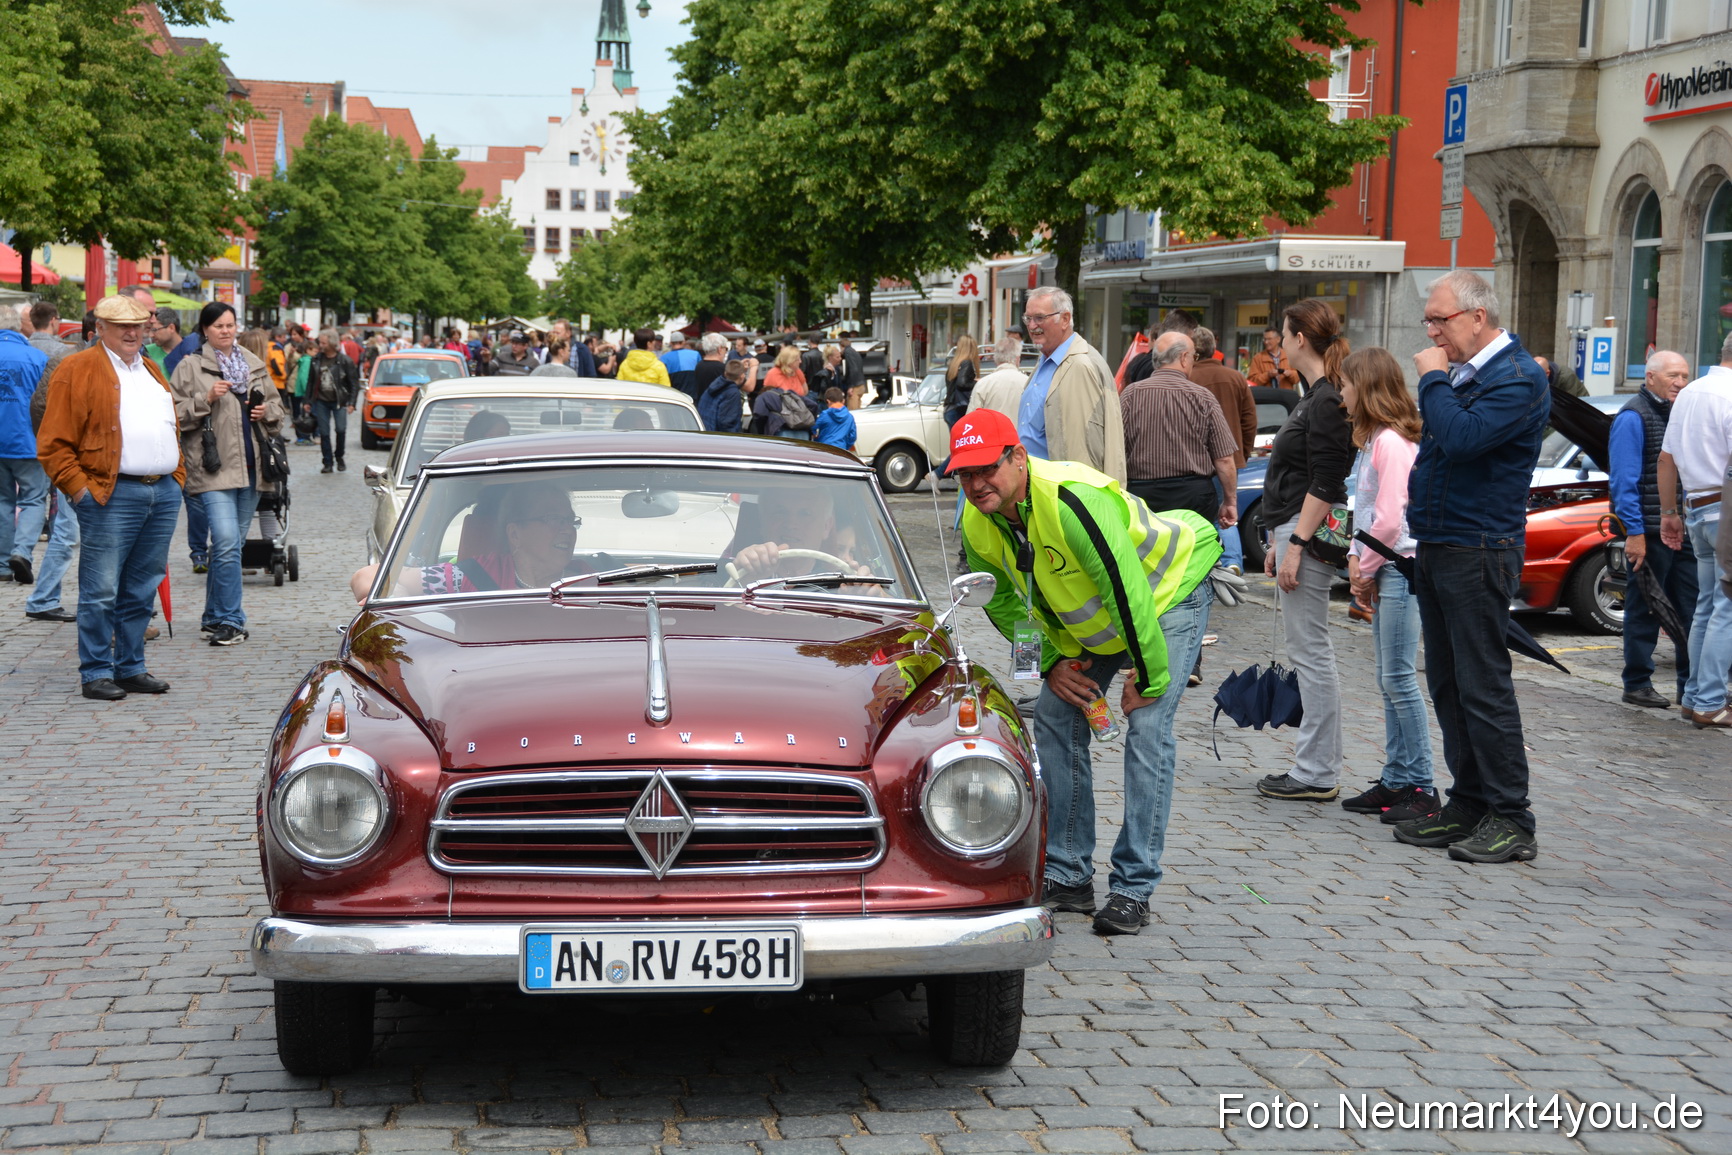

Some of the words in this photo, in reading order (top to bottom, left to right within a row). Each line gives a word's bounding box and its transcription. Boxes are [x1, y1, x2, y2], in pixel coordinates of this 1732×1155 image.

[1448, 93, 1462, 138] P
[1311, 260, 1372, 269] SCHLIERF
[1597, 341, 1609, 359] P
[955, 435, 984, 448] DEKRA
[467, 731, 849, 753] BORGWARD
[555, 940, 603, 982] AN
[632, 939, 680, 981] RV
[691, 937, 791, 980] 458H
[535, 966, 544, 979] D
